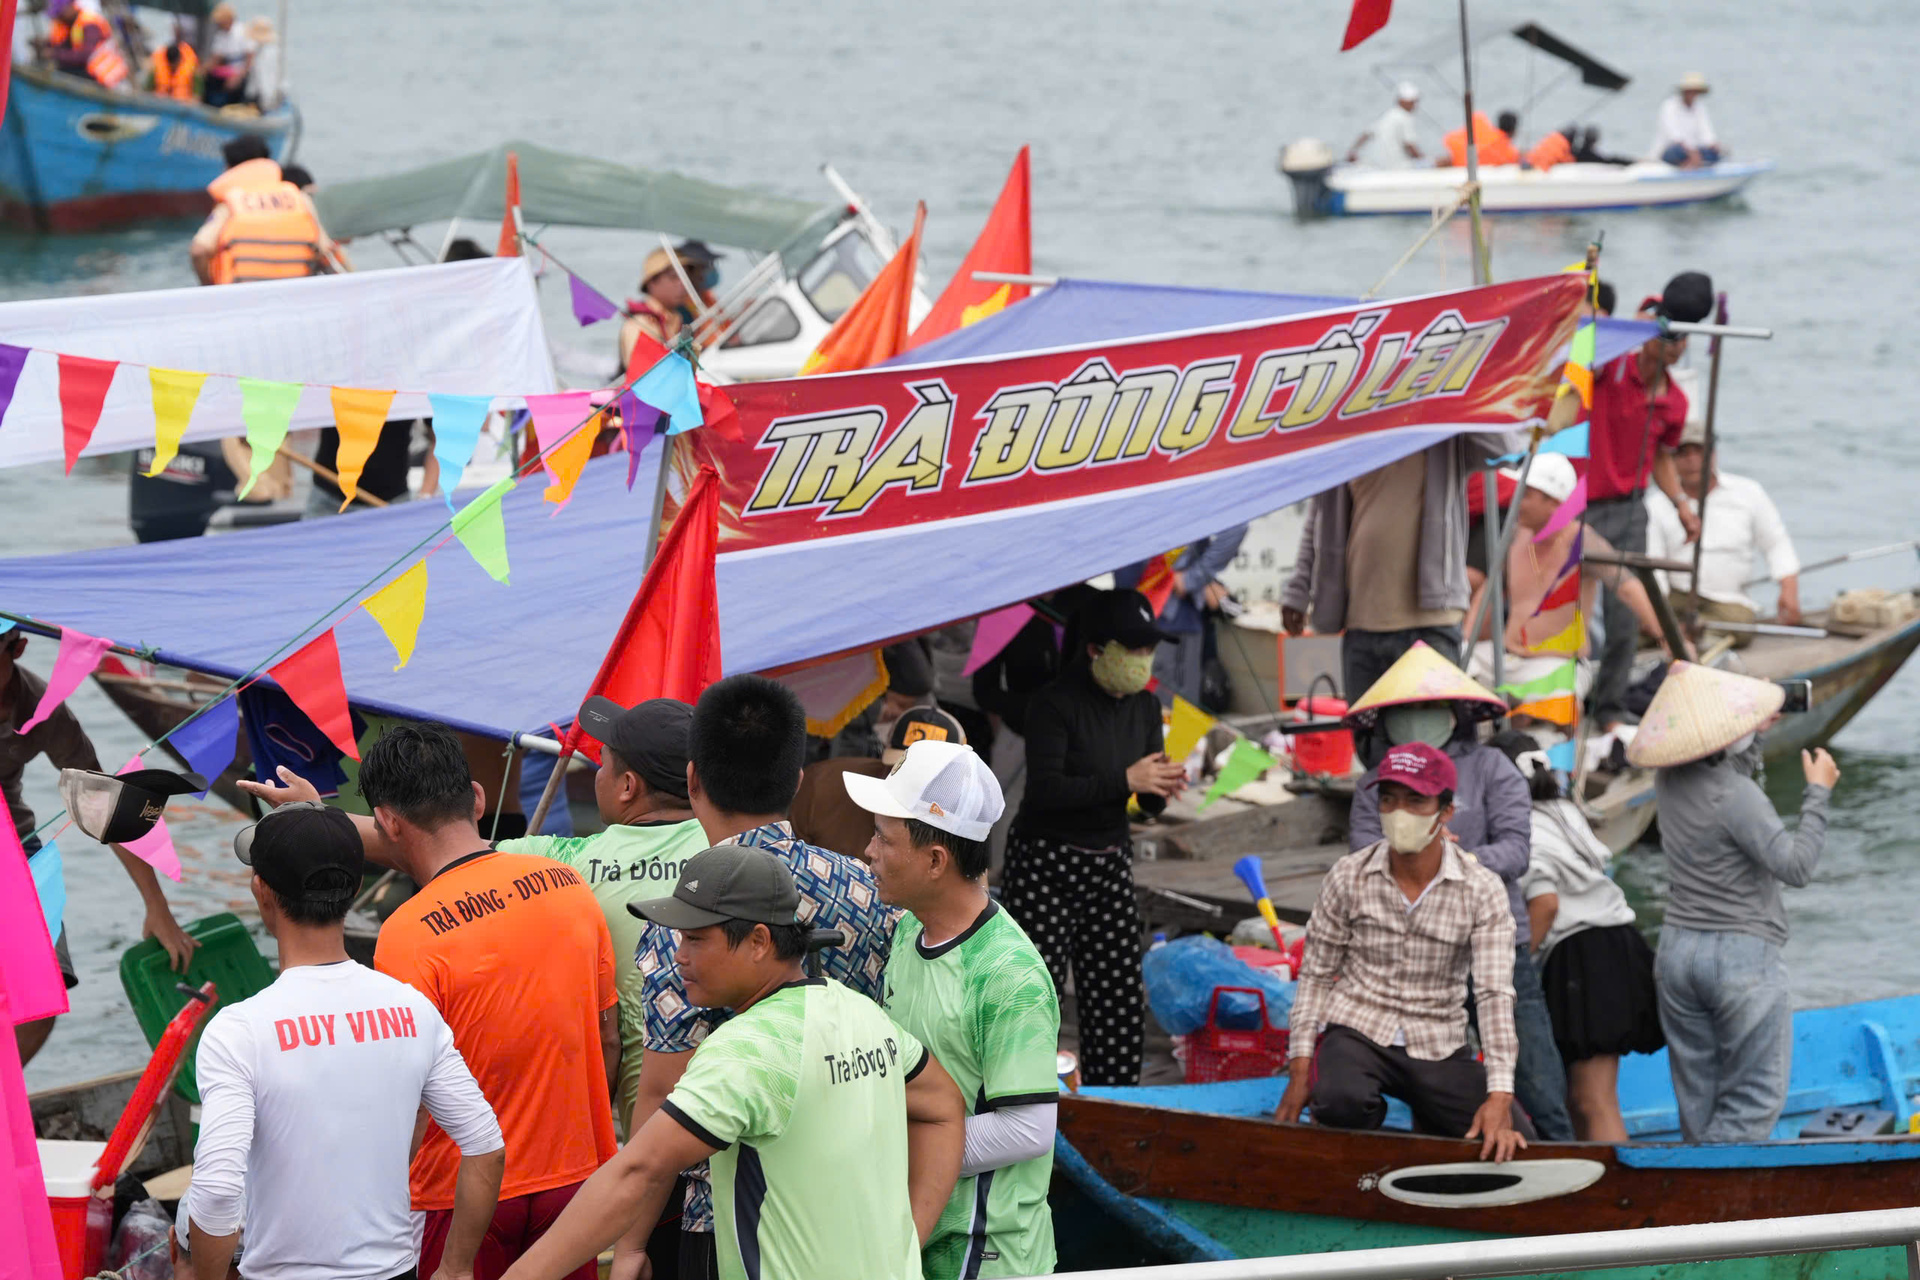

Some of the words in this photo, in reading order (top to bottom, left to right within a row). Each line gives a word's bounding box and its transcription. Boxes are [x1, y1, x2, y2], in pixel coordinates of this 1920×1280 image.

[742, 377, 957, 521] TRÀ
[960, 356, 1241, 488] ĐÔNG
[1226, 308, 1393, 443] CỐ
[1338, 309, 1511, 418] LÊN
[589, 858, 622, 884] Trà
[420, 901, 458, 936] TRÀ
[458, 890, 506, 924] ĐÔNG
[513, 870, 550, 901] DUY
[546, 867, 581, 890] VINH
[274, 1014, 336, 1052] DUY
[345, 1006, 418, 1044] VINH
[824, 1051, 851, 1085] Trà
